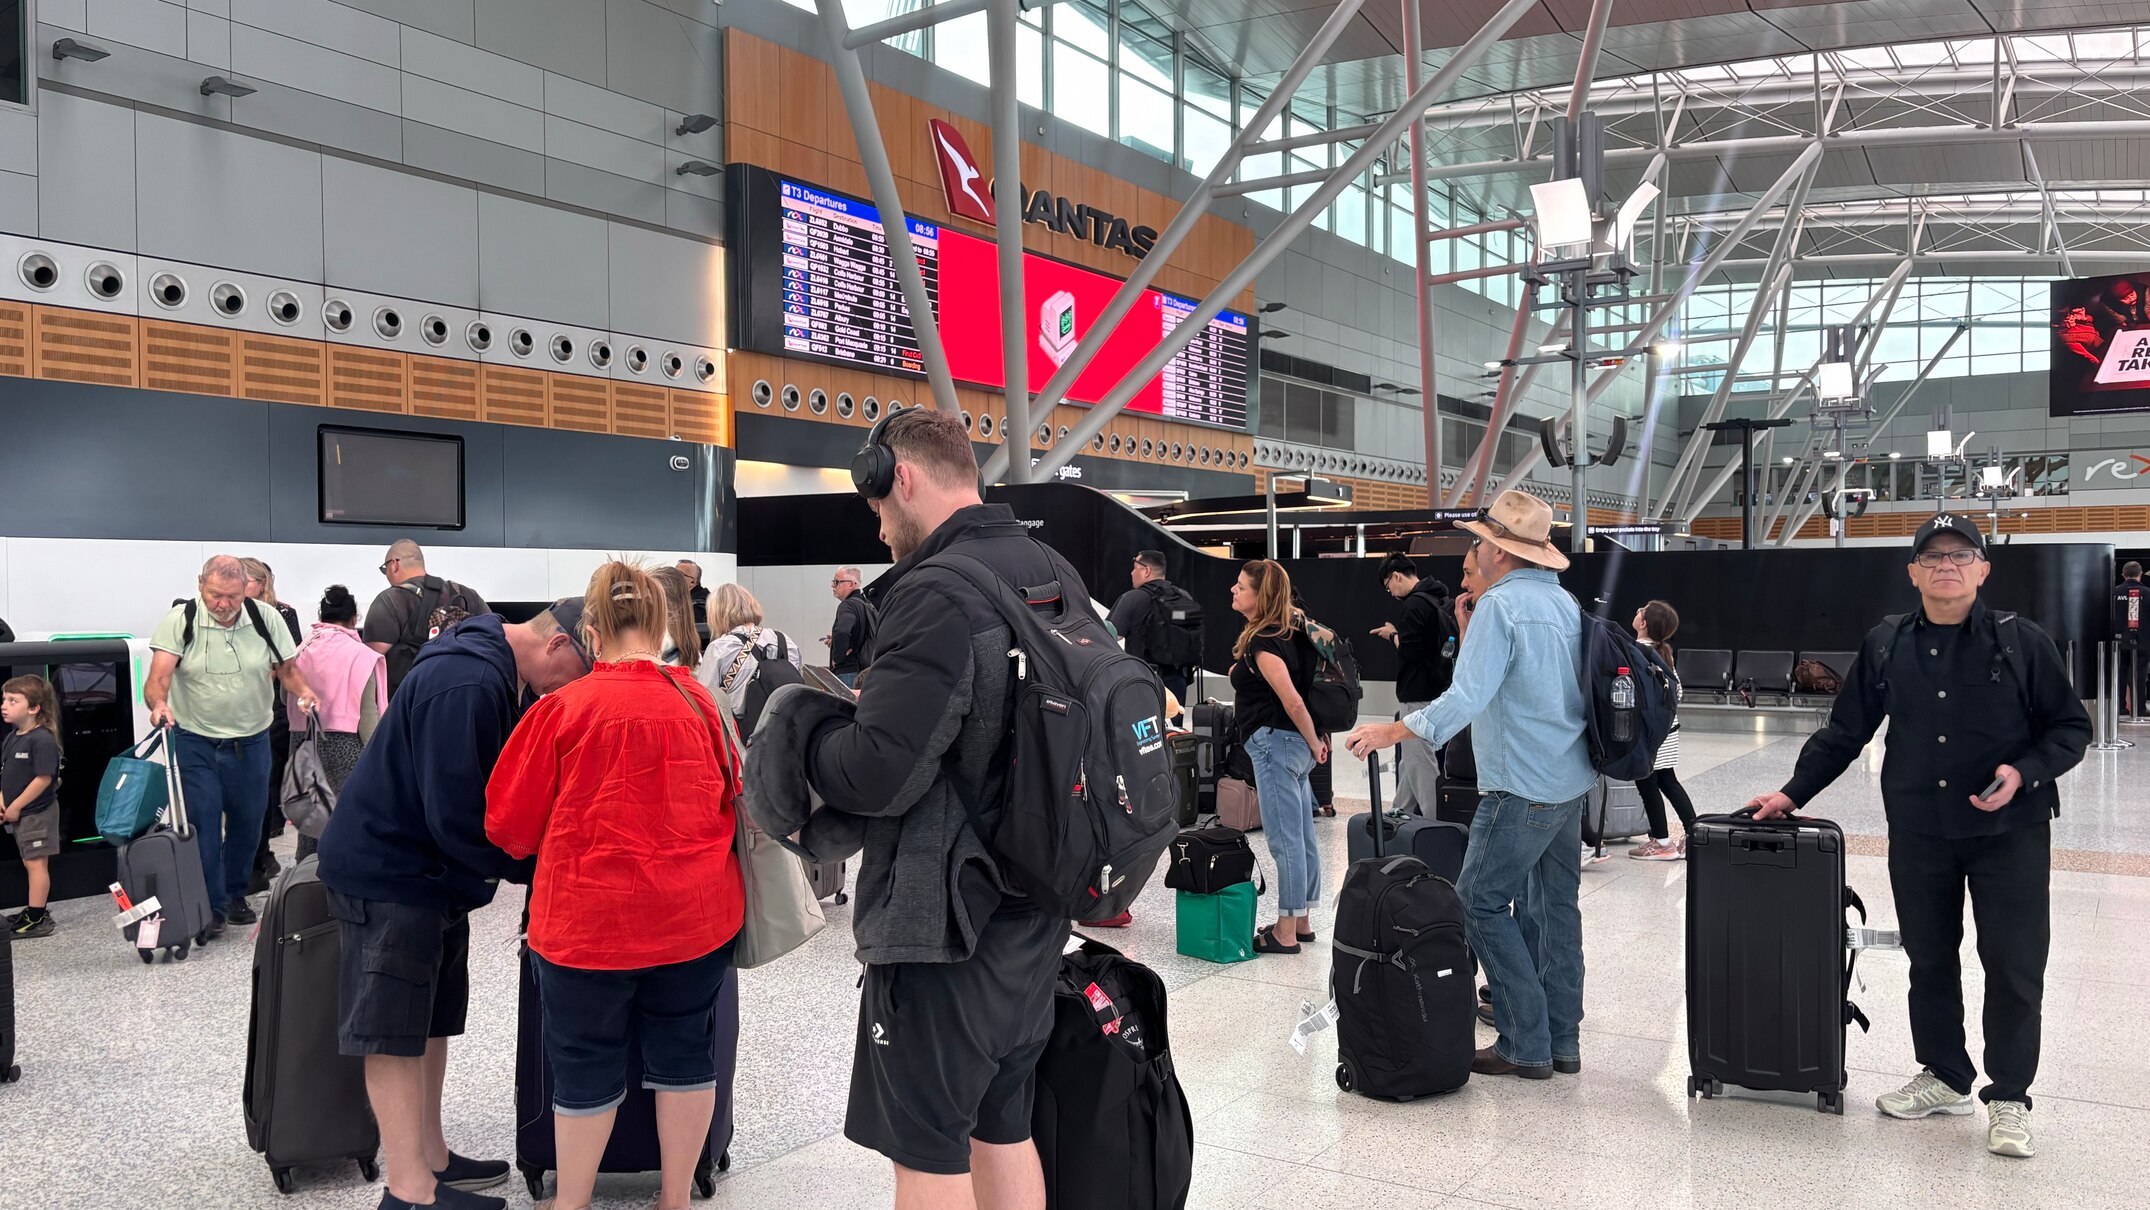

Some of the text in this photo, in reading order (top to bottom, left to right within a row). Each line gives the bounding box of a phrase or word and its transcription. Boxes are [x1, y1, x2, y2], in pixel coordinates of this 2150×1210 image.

[792, 186, 847, 211] T3 Departures
[833, 223, 848, 233] Dubbo
[915, 223, 934, 237] 08:56
[834, 256, 849, 268] Wagga
[850, 260, 866, 272] Wagga
[847, 272, 864, 281] Harbour
[847, 283, 864, 293] Harbour
[835, 314, 849, 324] Albury
[847, 328, 860, 336] Coast
[835, 337, 844, 345] Port
[1060, 464, 1082, 480] gates
[1132, 715, 1158, 740] VFT
[1413, 973, 1428, 1022] Kathmandu
